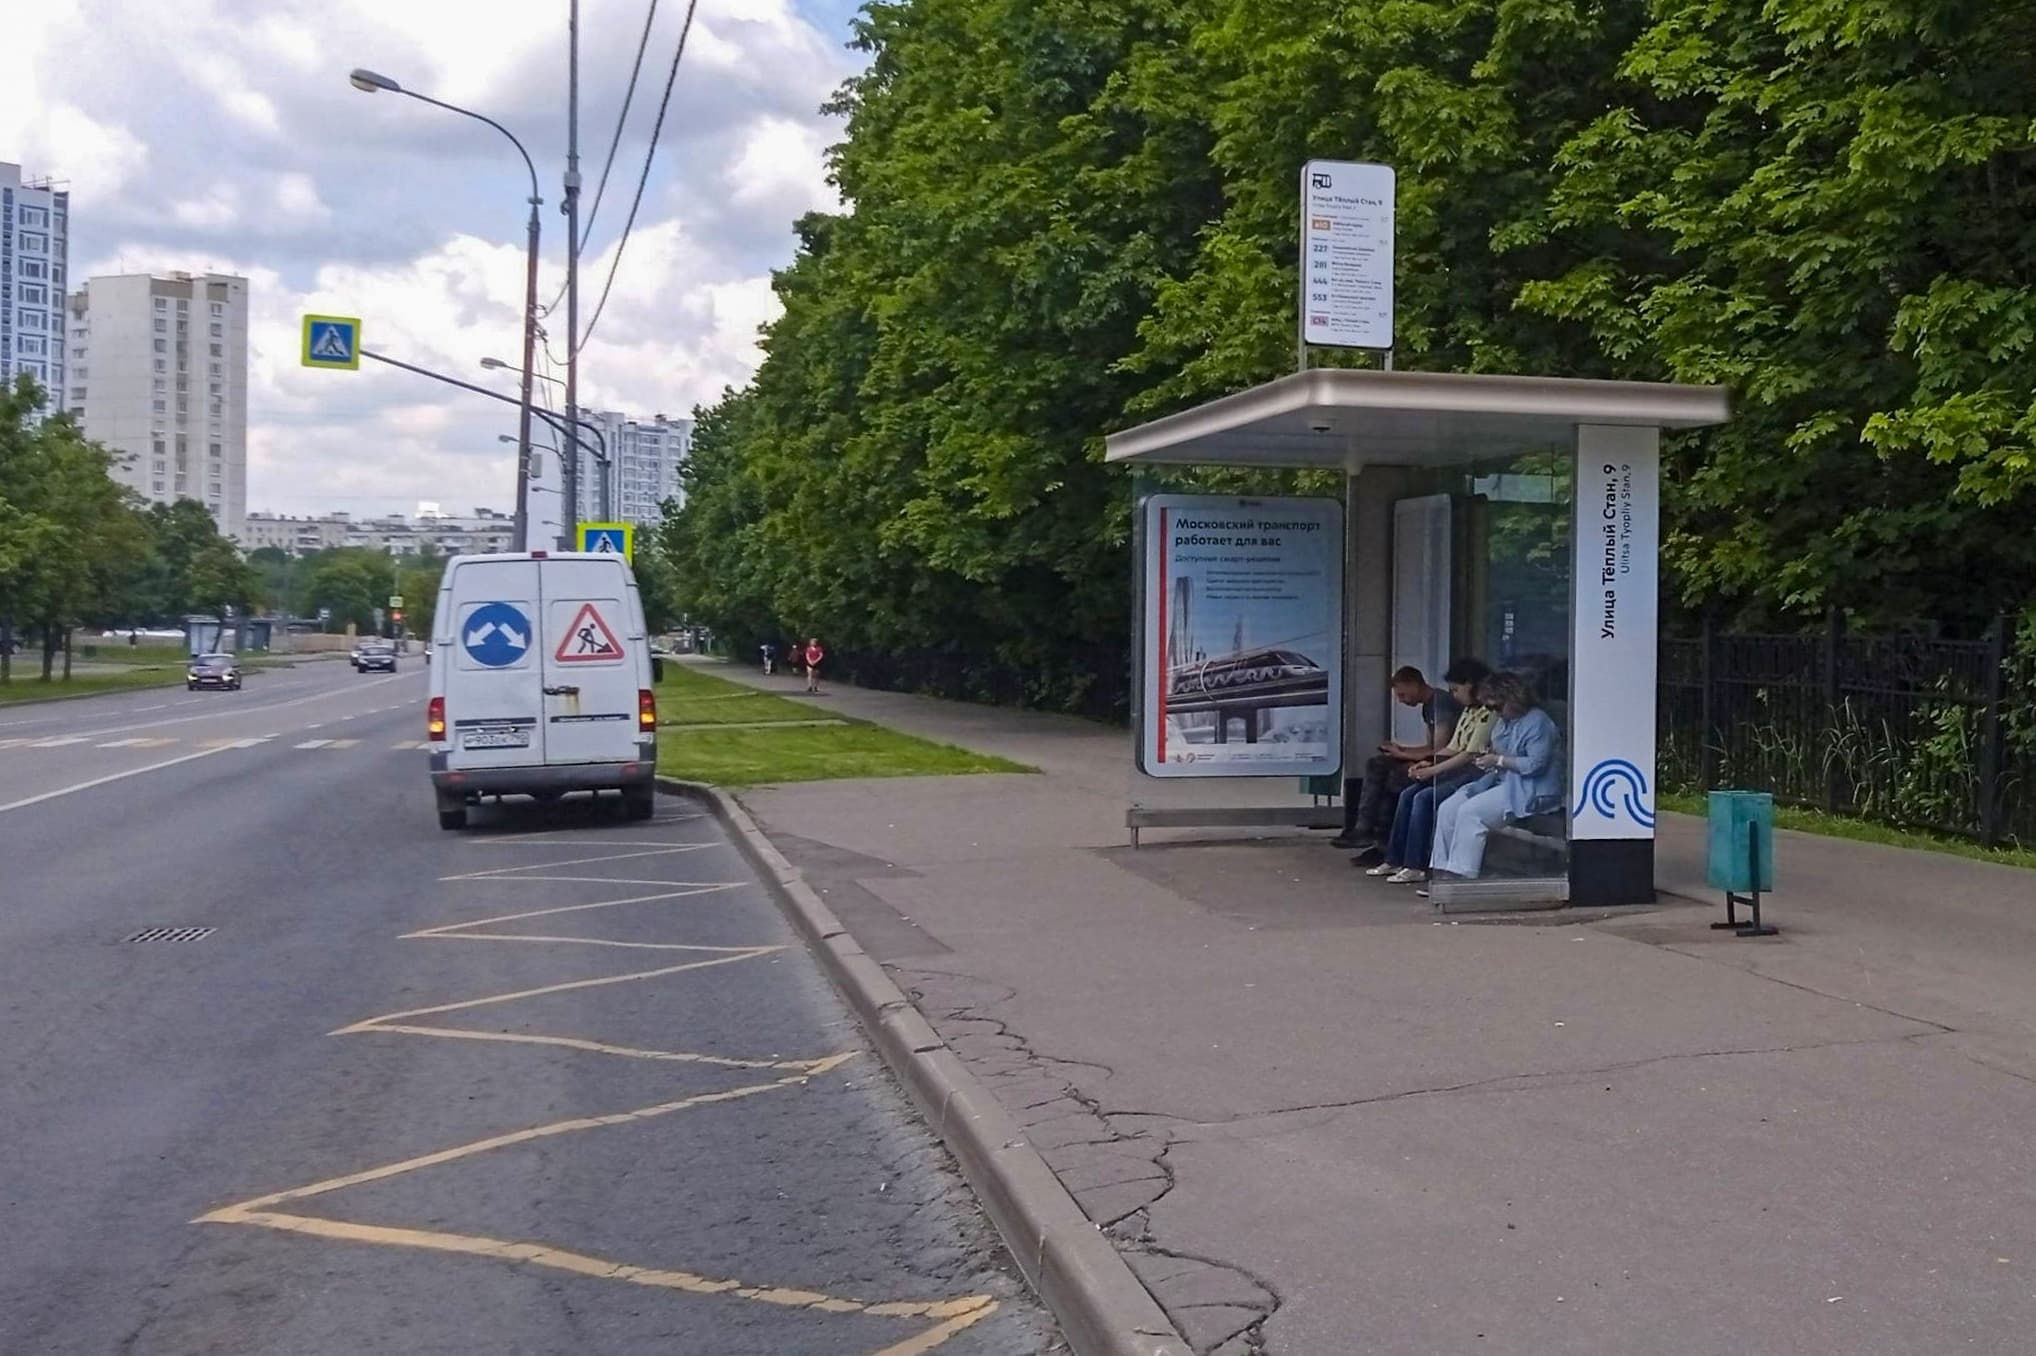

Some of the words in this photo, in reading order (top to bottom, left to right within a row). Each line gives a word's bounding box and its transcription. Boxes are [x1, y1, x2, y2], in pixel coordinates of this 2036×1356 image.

[1603, 464, 1616, 474] 9
[1603, 478, 1619, 520] Стан,
[1175, 518, 1254, 530] Московский
[1258, 521, 1321, 533] транспорт
[1175, 534, 1233, 548] работает
[1235, 537, 1258, 547] для
[1260, 537, 1281, 546] вас
[1602, 524, 1616, 586] Тёплый
[1620, 543, 1631, 574] Ulitsa
[1601, 590, 1616, 639] Улица
